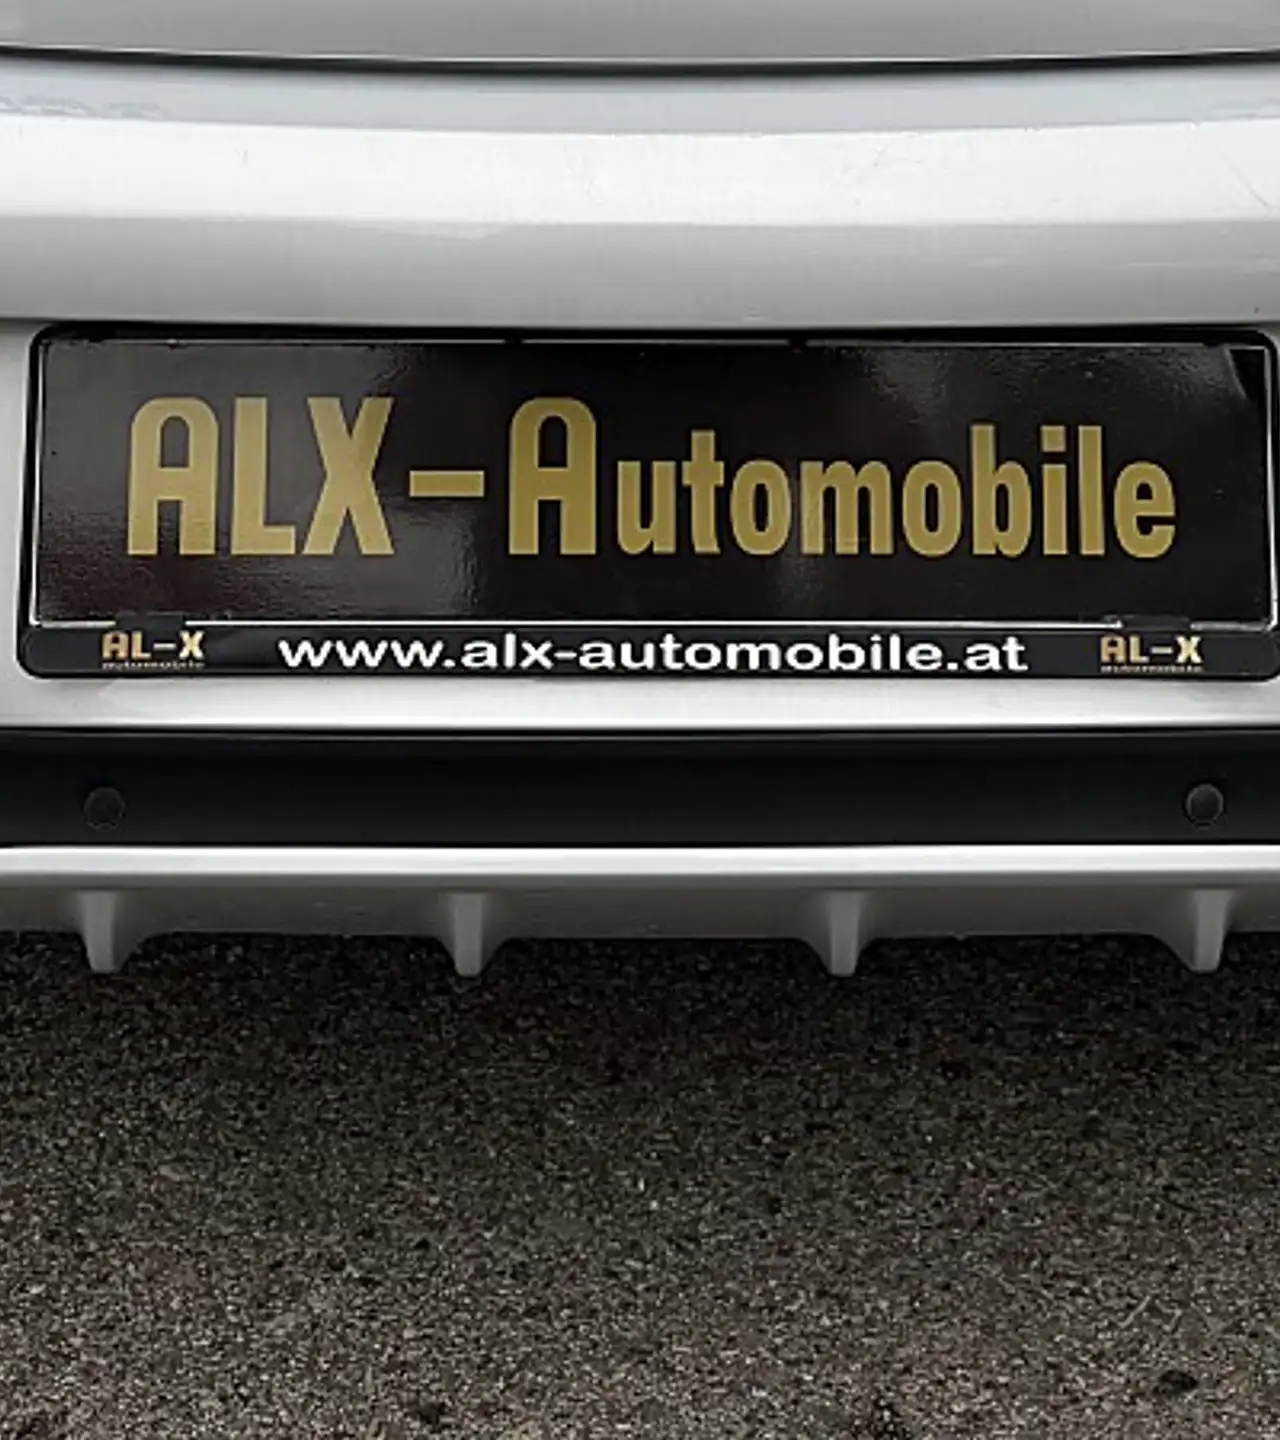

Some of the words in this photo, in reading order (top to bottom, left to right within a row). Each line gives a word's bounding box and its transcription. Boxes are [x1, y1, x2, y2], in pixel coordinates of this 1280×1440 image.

[127, 396, 1177, 558] ALX-Automobile
[102, 630, 205, 659] AL-X
[278, 634, 1029, 672] www.alx-automobile.at
[1100, 635, 1203, 664] AL-X
